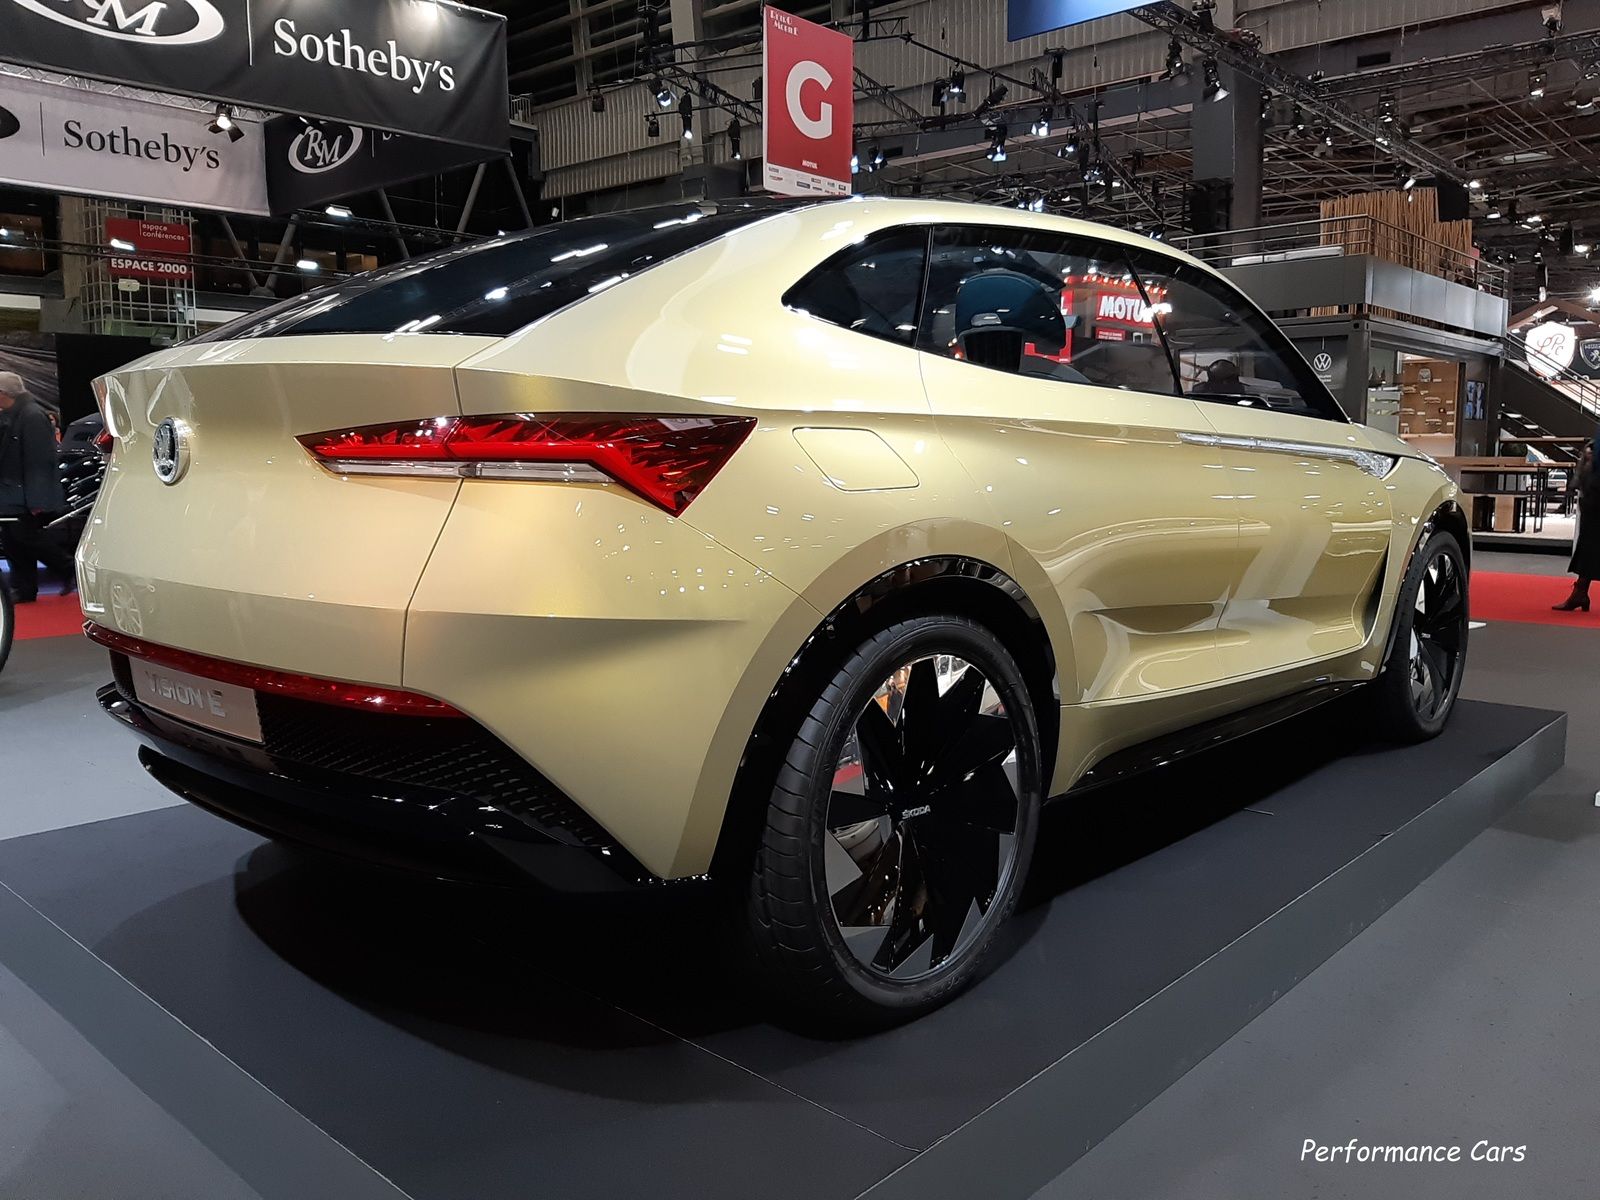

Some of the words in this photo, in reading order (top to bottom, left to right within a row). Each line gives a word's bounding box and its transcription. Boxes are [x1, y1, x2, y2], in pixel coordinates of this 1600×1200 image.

[273, 18, 456, 94] Sotheby's
[786, 60, 833, 139] G
[63, 119, 220, 172] Sotheby's
[304, 128, 342, 167] RM
[111, 258, 155, 271] ESPACE
[157, 262, 187, 275] 2000
